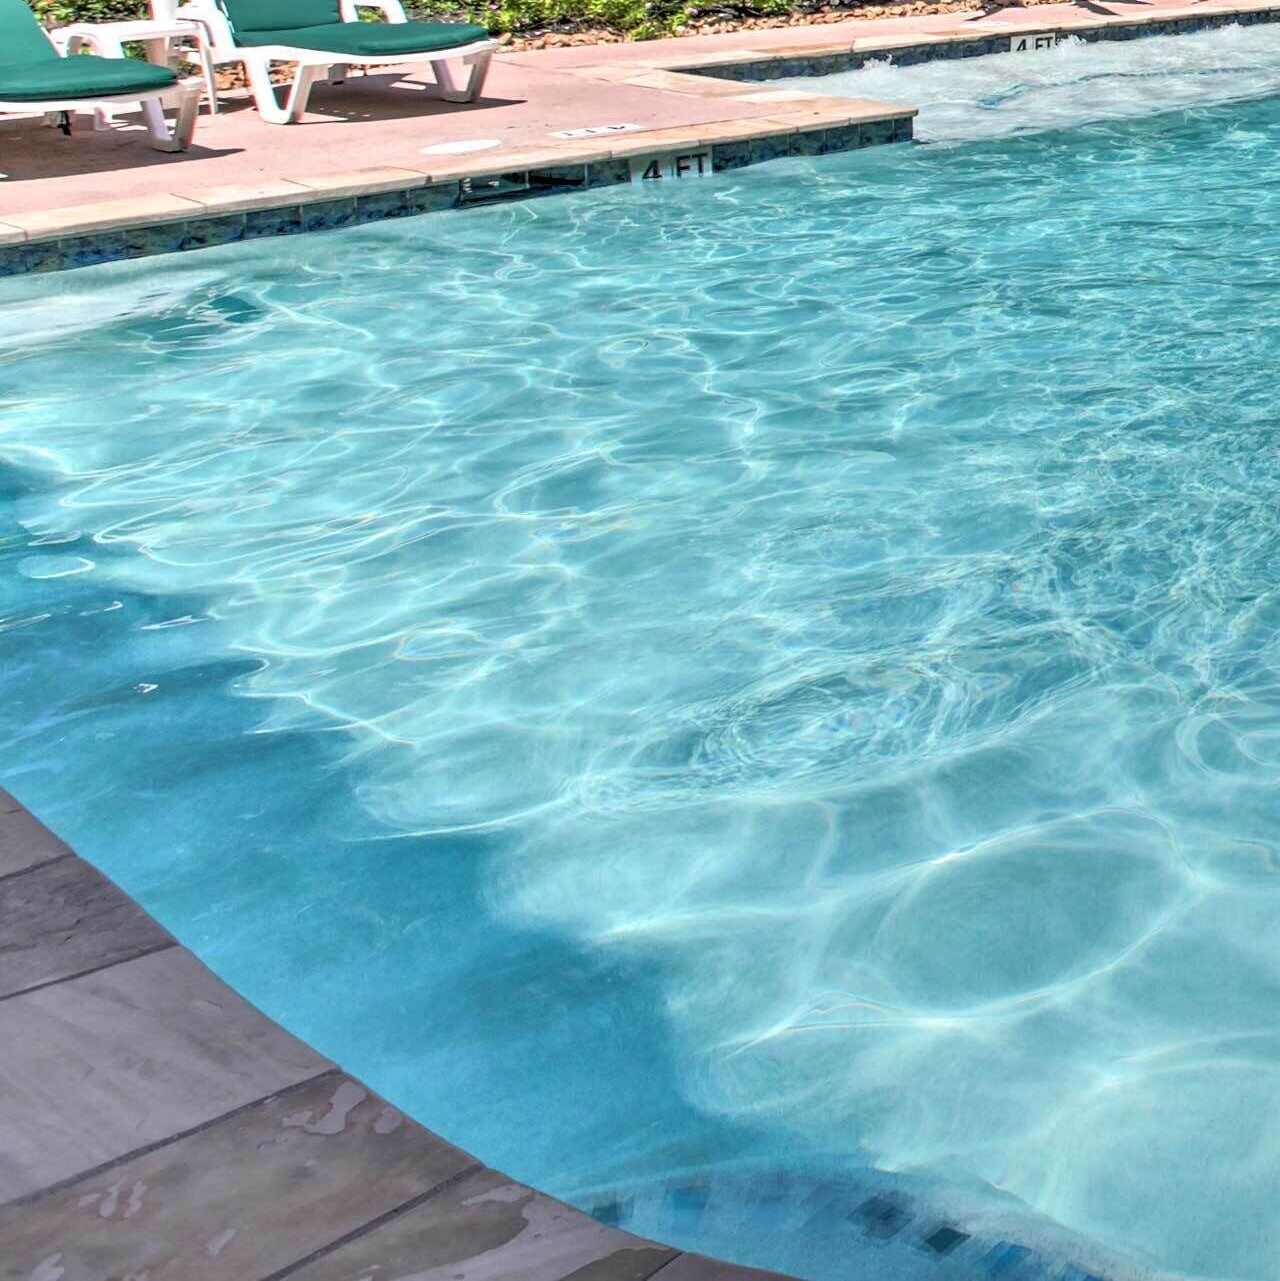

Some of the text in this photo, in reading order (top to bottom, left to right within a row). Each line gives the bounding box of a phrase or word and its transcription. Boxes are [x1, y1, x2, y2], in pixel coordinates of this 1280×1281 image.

[1016, 37, 1054, 52] 4 FT
[641, 152, 708, 179] 4 FT
